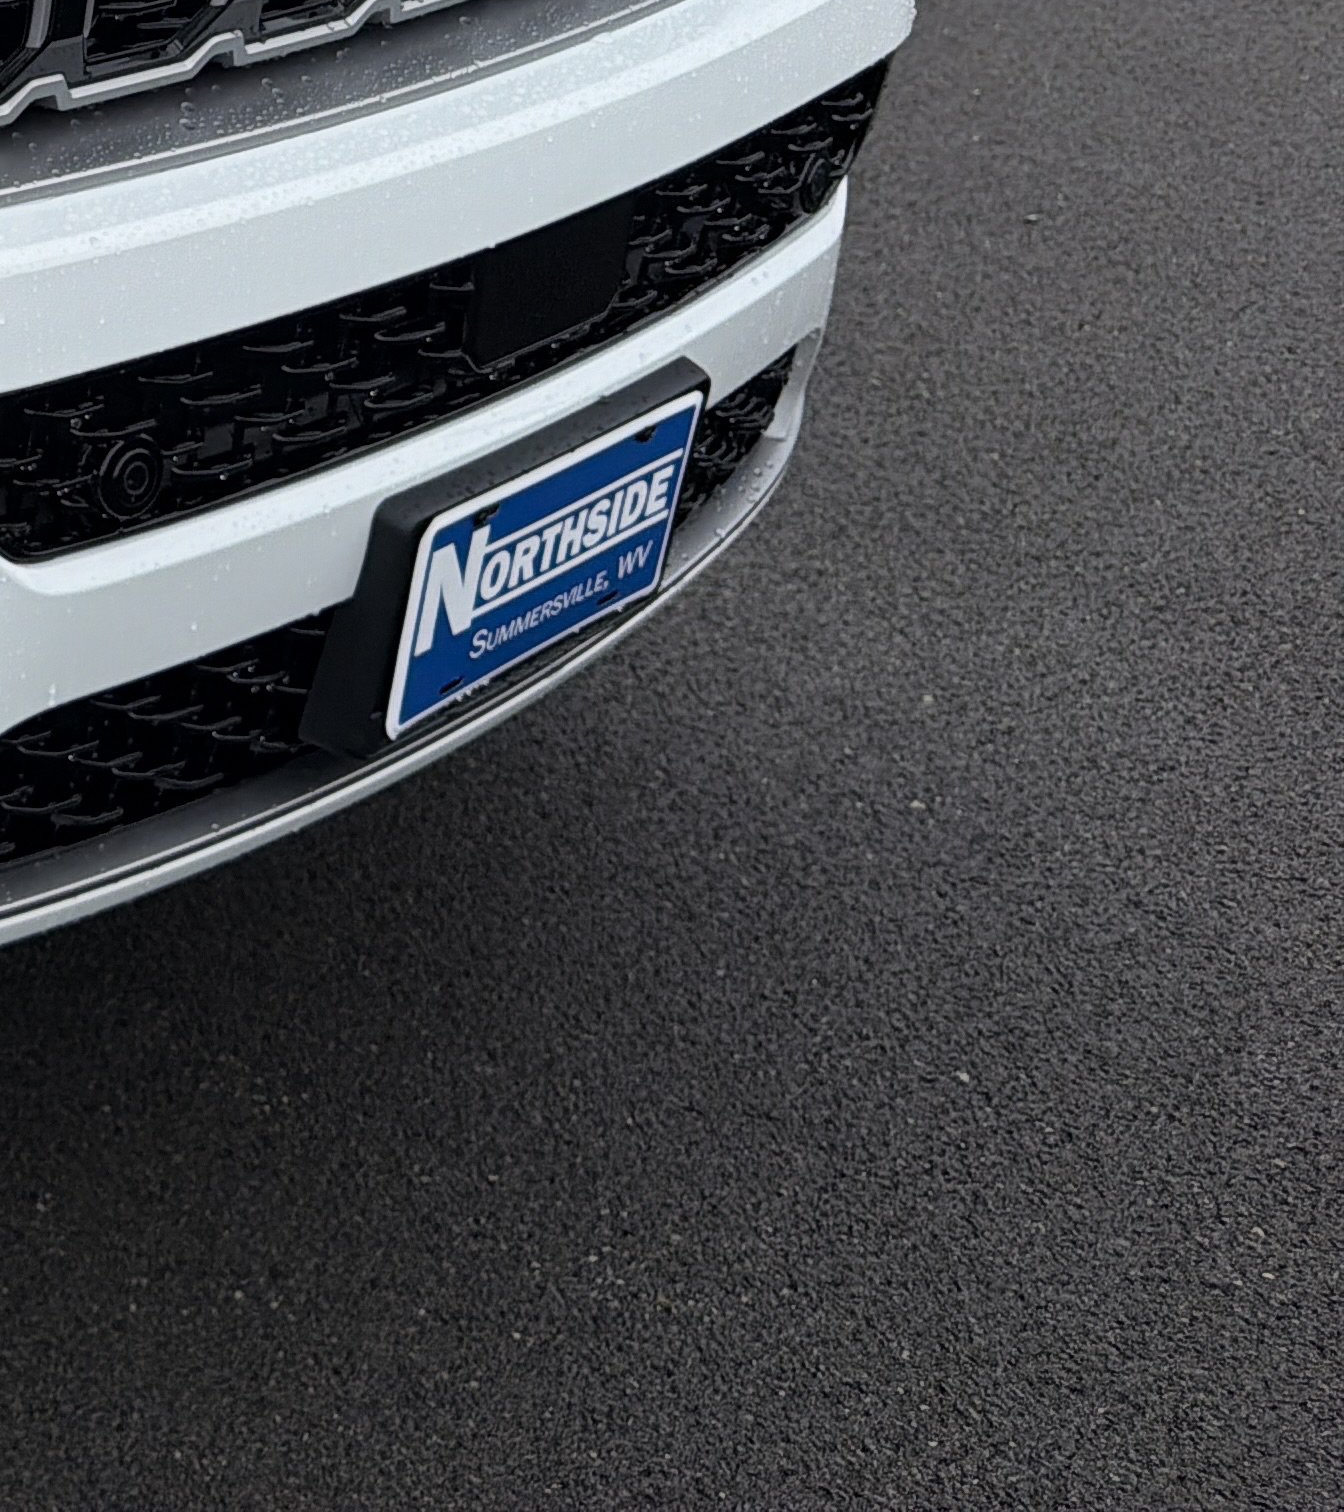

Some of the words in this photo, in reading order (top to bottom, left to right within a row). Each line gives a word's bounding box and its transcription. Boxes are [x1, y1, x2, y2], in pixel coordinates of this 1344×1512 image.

[414, 464, 675, 656] NORTHSIDE
[468, 569, 610, 659] SUMMERSVILLE,
[617, 539, 654, 579] WV
